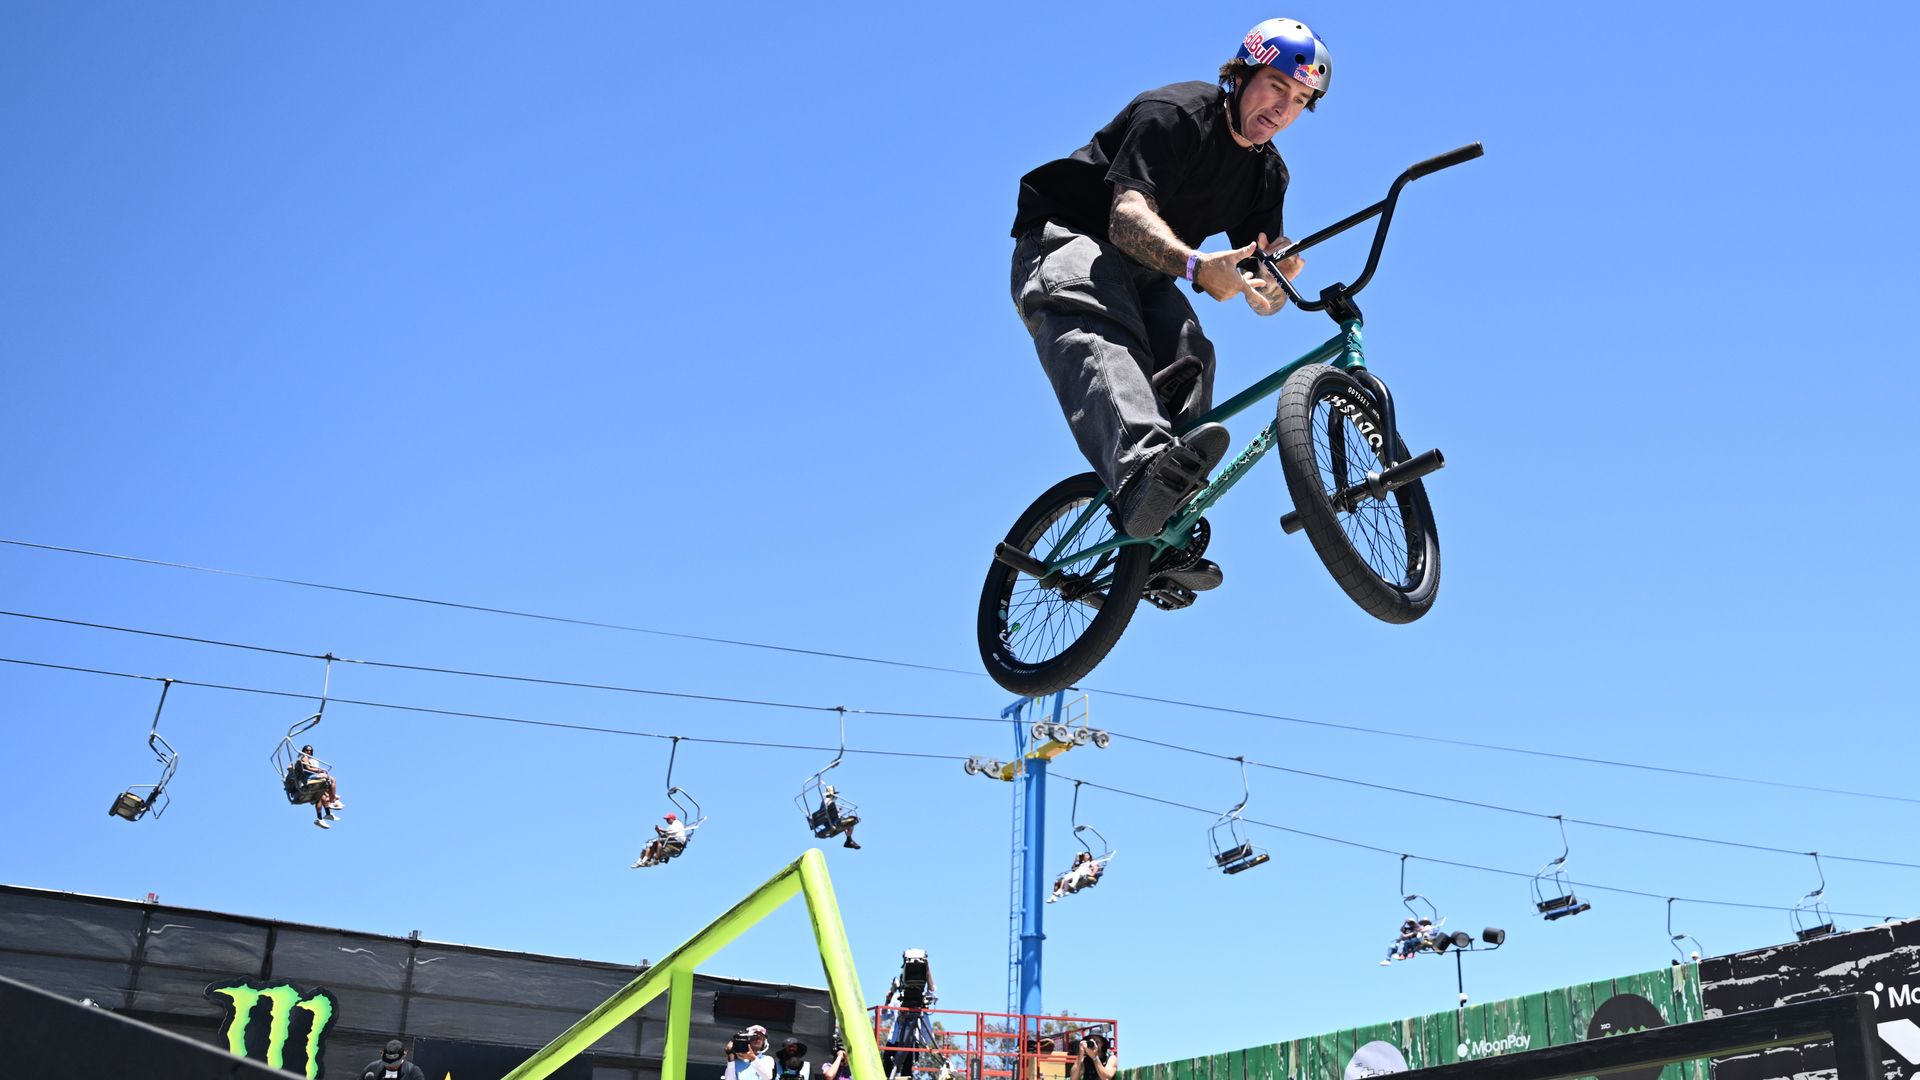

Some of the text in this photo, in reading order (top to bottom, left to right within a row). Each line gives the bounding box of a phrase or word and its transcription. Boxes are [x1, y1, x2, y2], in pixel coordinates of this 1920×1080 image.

[1249, 33, 1279, 65] Bull
[1348, 386, 1370, 407] ODYSSEY
[1472, 1034, 1531, 1056] MoonPay
